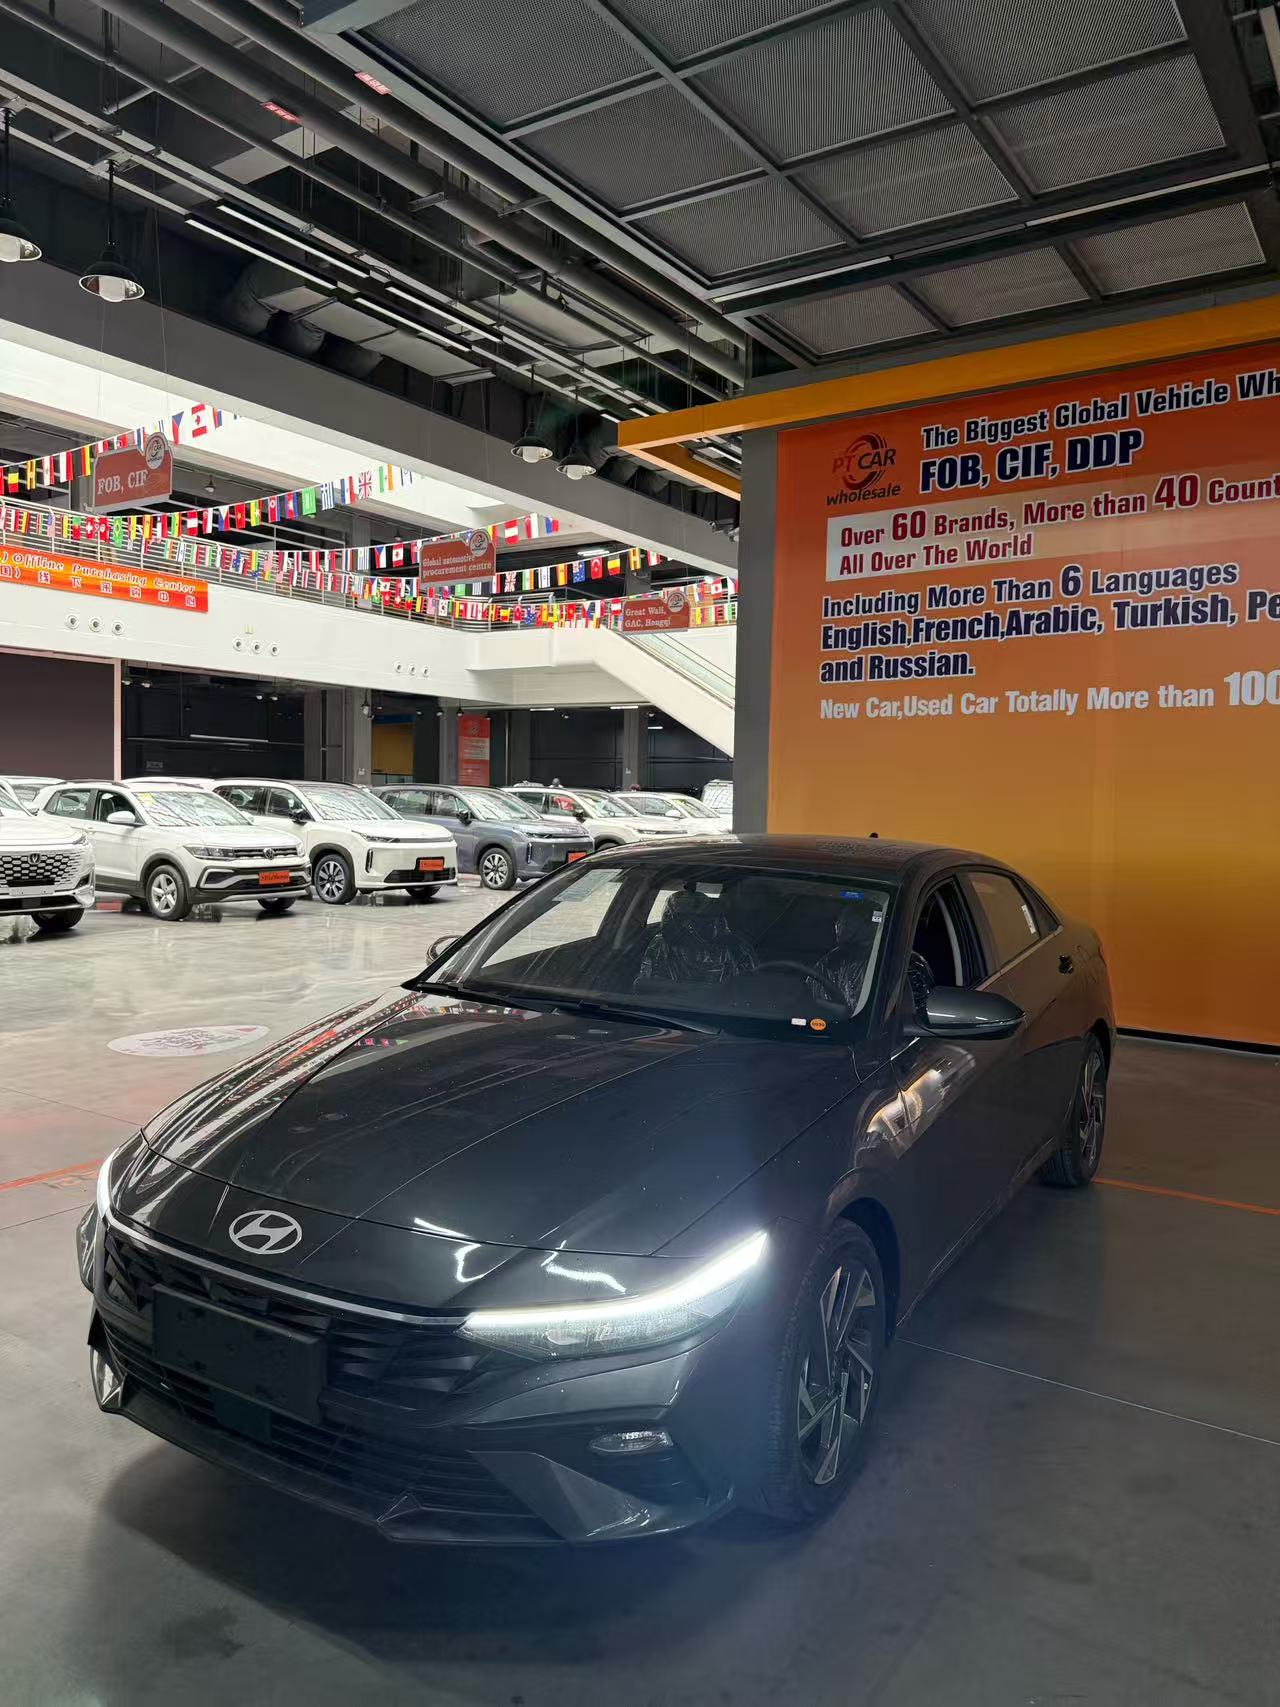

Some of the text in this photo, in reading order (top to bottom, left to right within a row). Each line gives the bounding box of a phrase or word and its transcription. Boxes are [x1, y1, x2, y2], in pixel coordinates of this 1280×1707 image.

[921, 425, 959, 450] The
[964, 412, 1049, 445] Biggest
[1054, 395, 1128, 428] Global
[1135, 381, 1230, 416] Vehicle
[858, 448, 896, 469] CAR
[919, 428, 1144, 493] FOB, CIF, DDP
[97, 469, 148, 494] FOB, CIF
[826, 483, 901, 506] wholesale
[841, 525, 885, 548] Over
[891, 509, 927, 541] 60
[933, 507, 1016, 536] Brands,
[1023, 498, 1086, 526] More
[1092, 491, 1146, 517] than
[1152, 473, 1200, 510] 40
[422, 561, 492, 578] procurement centre
[839, 533, 1033, 575] All Over The World
[72, 563, 148, 587] Purchasing
[153, 577, 196, 593] Center
[822, 562, 1239, 619] Including More Than 6 Languages
[625, 607, 646, 617] Great
[1112, 592, 1239, 630] Turkish,
[820, 650, 976, 684] and Russian.
[820, 699, 860, 719] New
[961, 692, 999, 715] Car
[1005, 688, 1079, 716] Totally
[1086, 687, 1149, 711] More
[1157, 684, 1215, 708] than
